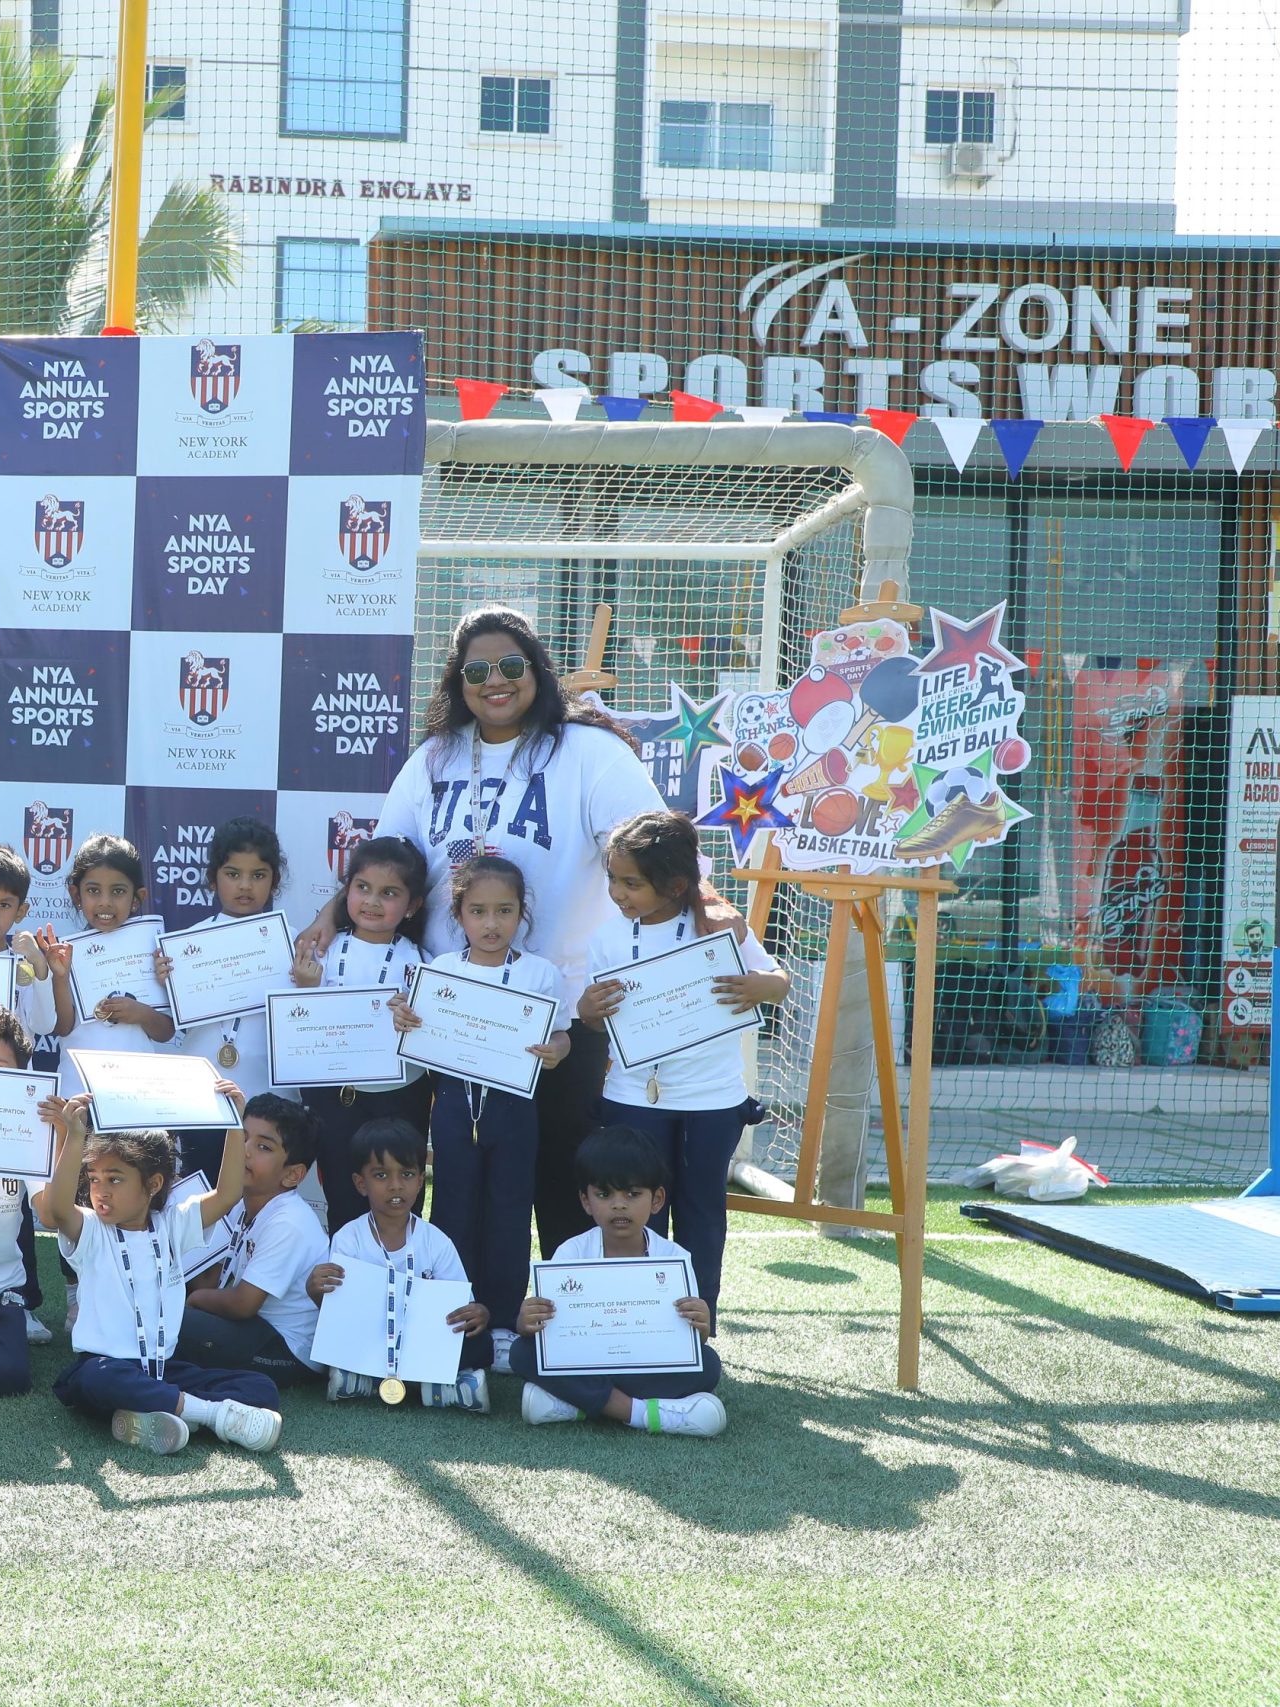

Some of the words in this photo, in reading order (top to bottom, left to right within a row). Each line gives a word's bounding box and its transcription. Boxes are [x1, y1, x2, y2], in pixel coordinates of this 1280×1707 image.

[210, 174, 346, 198] RABINDRA
[359, 180, 471, 202] ENCLAVE
[800, 278, 868, 349] A
[940, 282, 1194, 357] ZONE
[43, 361, 85, 378] NYA
[350, 356, 395, 373] NYA
[20, 380, 110, 398] ANNUAL
[324, 376, 419, 395] ANNUAL
[531, 348, 982, 420] SPORTS
[23, 401, 104, 420] SPORTS
[327, 397, 413, 416] SPORTS
[42, 422, 83, 440] DAY
[348, 419, 391, 438] DAY
[179, 437, 208, 448] NEW
[212, 437, 248, 448] YORK
[188, 450, 237, 459] ACADEMY
[188, 515, 231, 533] NYA
[164, 535, 255, 553] ANNUAL
[167, 556, 251, 574] SPORTS
[187, 577, 228, 595] DAY
[23, 590, 52, 601] NEW
[56, 590, 90, 601] YORK
[327, 594, 357, 605] NEW
[361, 594, 397, 605] YORK
[32, 603, 81, 613] ACADEMY
[335, 608, 387, 617] ACADEMY
[32, 666, 75, 684] NYA
[839, 664, 871, 675] SPORTS
[846, 672, 864, 680] DAY
[337, 673, 381, 691] NYA
[921, 667, 967, 698] LIFE
[8, 687, 99, 706] ANNUAL
[311, 694, 403, 713] ANNUAL
[931, 694, 945, 703] LIKE
[921, 692, 972, 722] KEEP
[1110, 702, 1168, 726] STING
[11, 707, 94, 726] SPORTS
[315, 715, 399, 734] SPORTS
[917, 697, 1016, 740] SWINGING
[31, 728, 73, 746] DAY
[737, 716, 796, 741] THANKS
[168, 748, 197, 759] NEW
[202, 748, 237, 760] YORK
[335, 736, 378, 755] DAY
[917, 739, 960, 765] LAST
[964, 725, 1007, 753] BALL
[176, 761, 227, 771] ACADEMY
[786, 760, 830, 795] CHEER
[428, 772, 553, 850] USA
[177, 888, 215, 906] DAY
[1103, 881, 1165, 922] STING
[616, 1299, 661, 1307] PARTICIPATION
